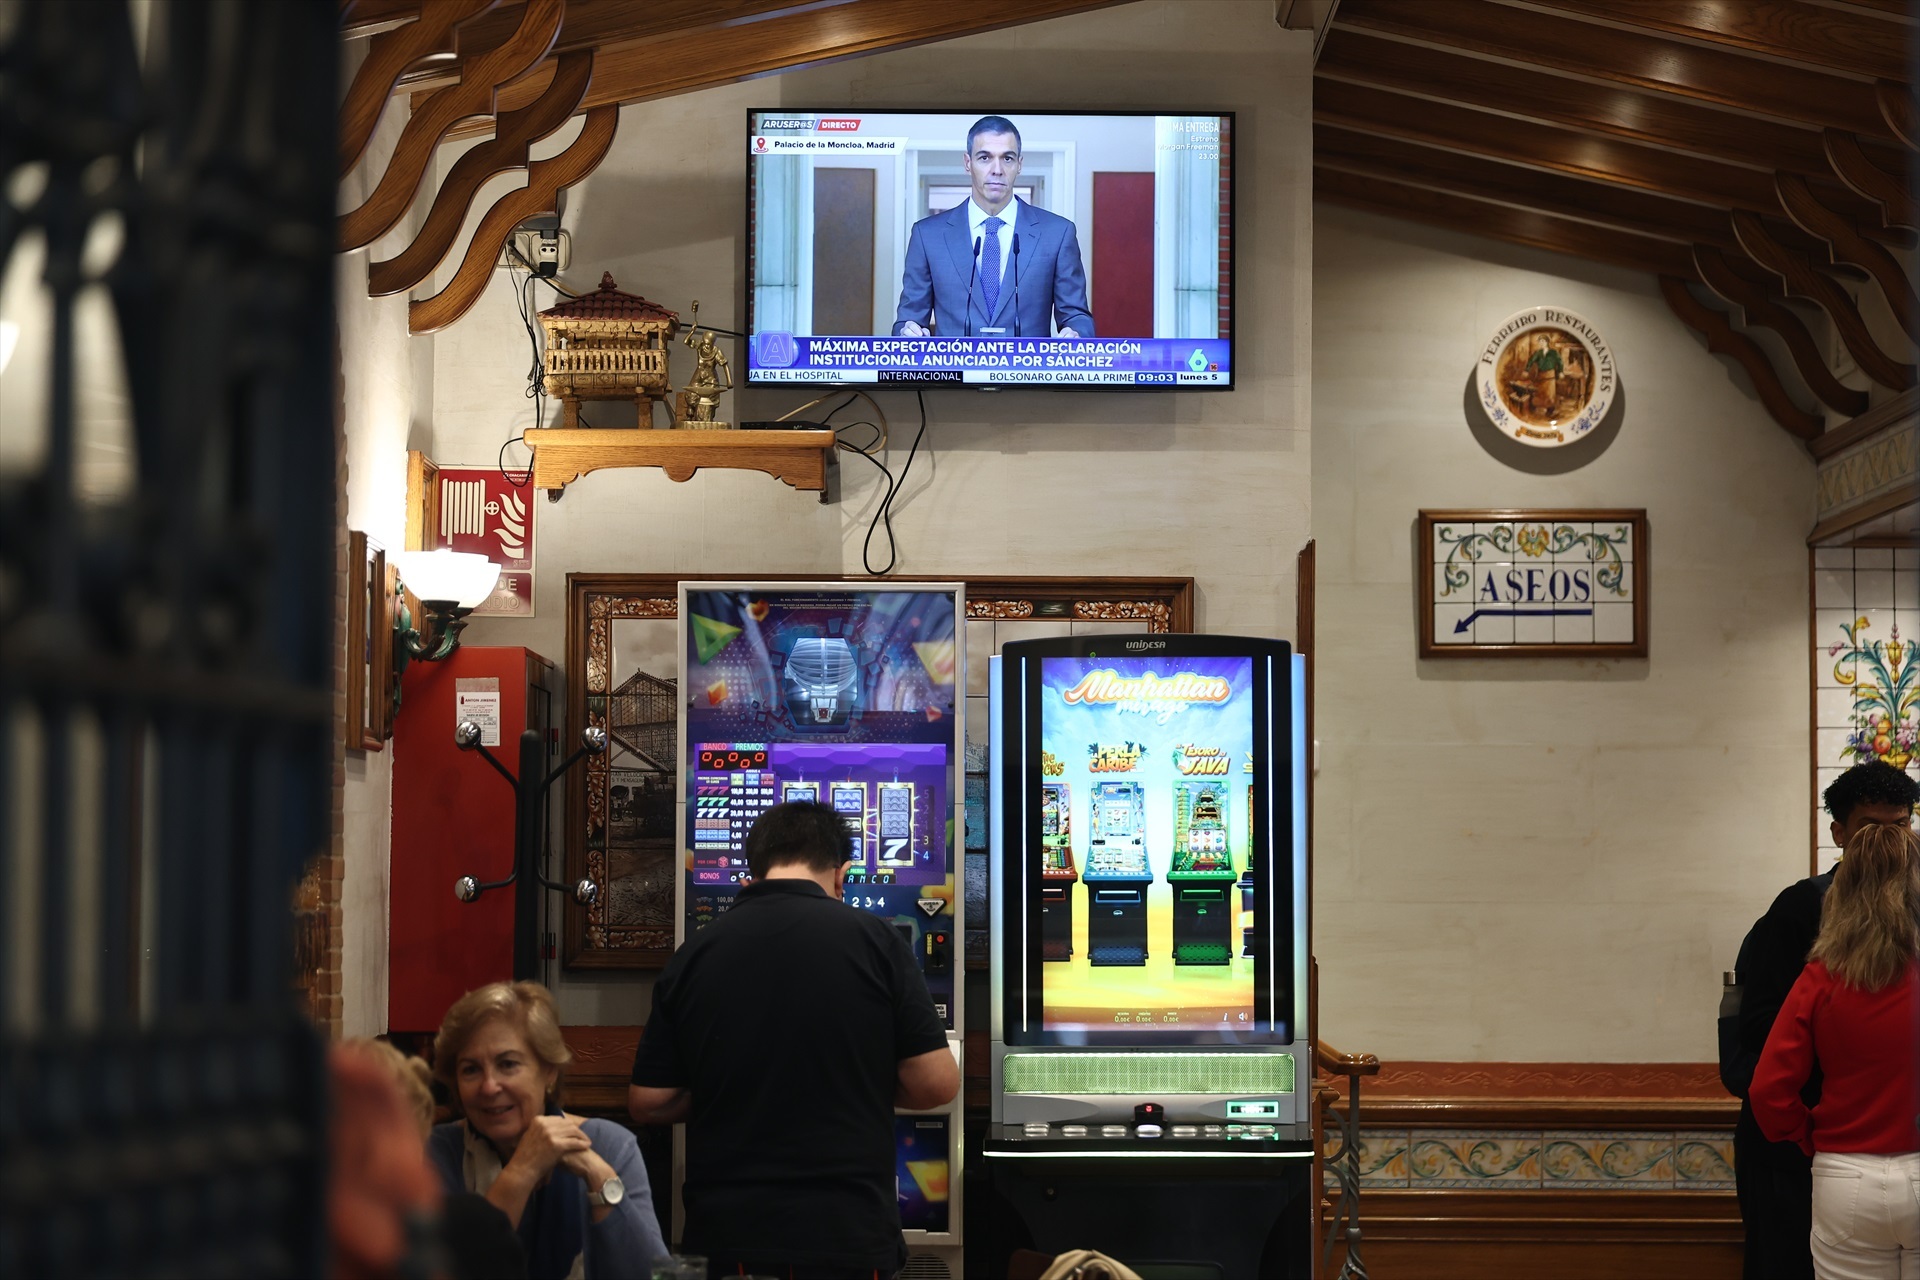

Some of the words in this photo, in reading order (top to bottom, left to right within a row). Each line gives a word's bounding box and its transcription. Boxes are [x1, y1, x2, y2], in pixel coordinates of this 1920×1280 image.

[1186, 122, 1219, 132] ENTREGA
[810, 338, 869, 352] MÁXIMA
[873, 339, 970, 352] EXPECTACIÓN
[976, 342, 1014, 353] ANTE
[1018, 342, 1036, 353] LA
[1039, 340, 1141, 354] DECLARACIÓN
[1482, 314, 1537, 366] FERREIRO
[1545, 309, 1613, 393] RESTAURANTES
[810, 354, 918, 366] INSTITUCIONAL
[922, 355, 1008, 366] ANUNCIADA
[1013, 356, 1042, 367] POR
[1046, 353, 1113, 367] SÁNCHEZ
[795, 372, 843, 380] HOSPITAL
[879, 372, 961, 381] INTERNACIONAL
[989, 372, 1052, 381] BOLSONARO
[1055, 373, 1084, 382] GANA
[1088, 373, 1100, 382] LA
[1104, 374, 1133, 382] PRIME
[1138, 374, 1174, 382] 09:03
[498, 578, 518, 590] DE
[1480, 569, 1591, 602] ASEOS
[1067, 671, 1228, 701] Manhattan
[1098, 744, 1140, 758] PERLA
[1089, 758, 1137, 773] CARIBE
[1182, 758, 1230, 775] JAVA
[924, 836, 929, 845] 3
[923, 851, 929, 860] 4
[700, 872, 720, 880] BONOS
[852, 896, 859, 907] 2
[865, 896, 872, 907] 3
[877, 896, 885, 907] 4
